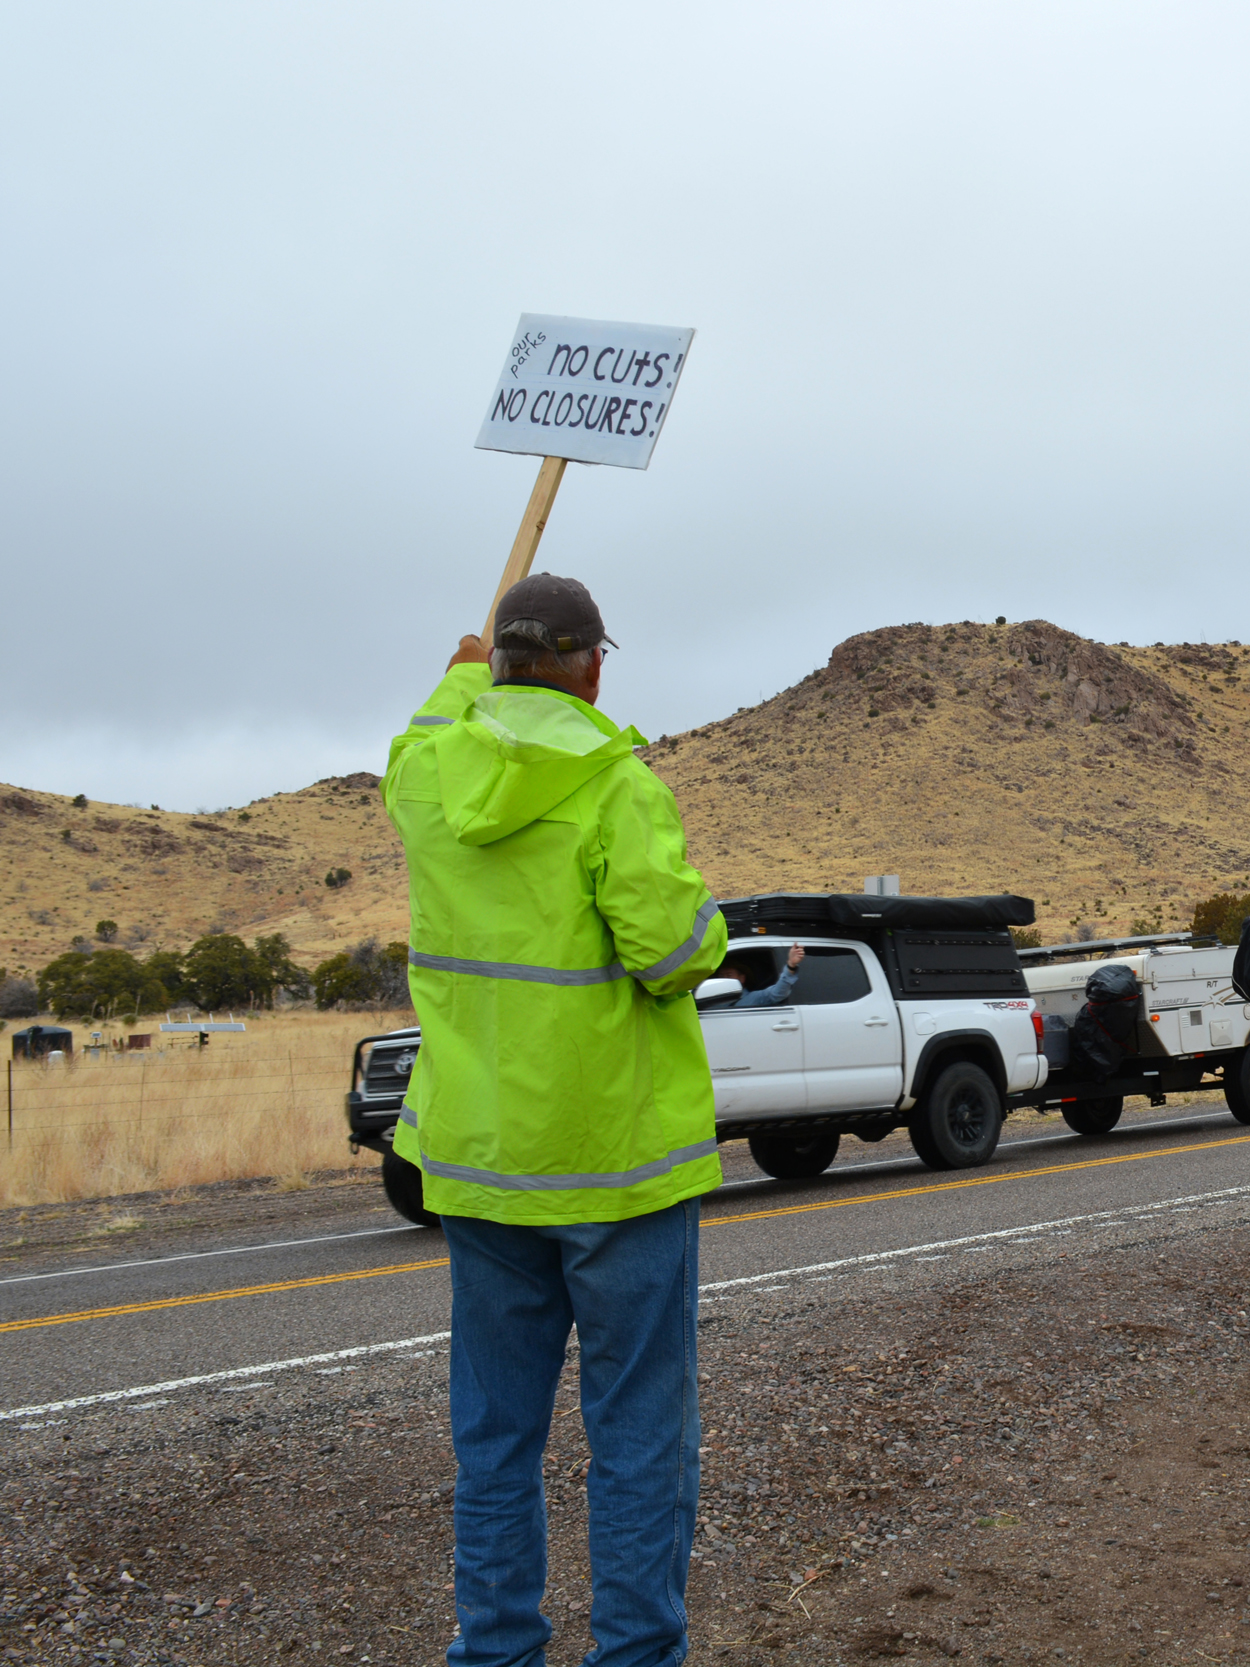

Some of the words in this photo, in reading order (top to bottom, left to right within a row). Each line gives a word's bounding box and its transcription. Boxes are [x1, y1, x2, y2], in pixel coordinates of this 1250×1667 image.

[510, 331, 547, 379] parks
[511, 331, 531, 358] our
[491, 388, 527, 423] NO
[530, 390, 666, 438] CLOSURES!
[983, 1001, 1008, 1011] TRD
